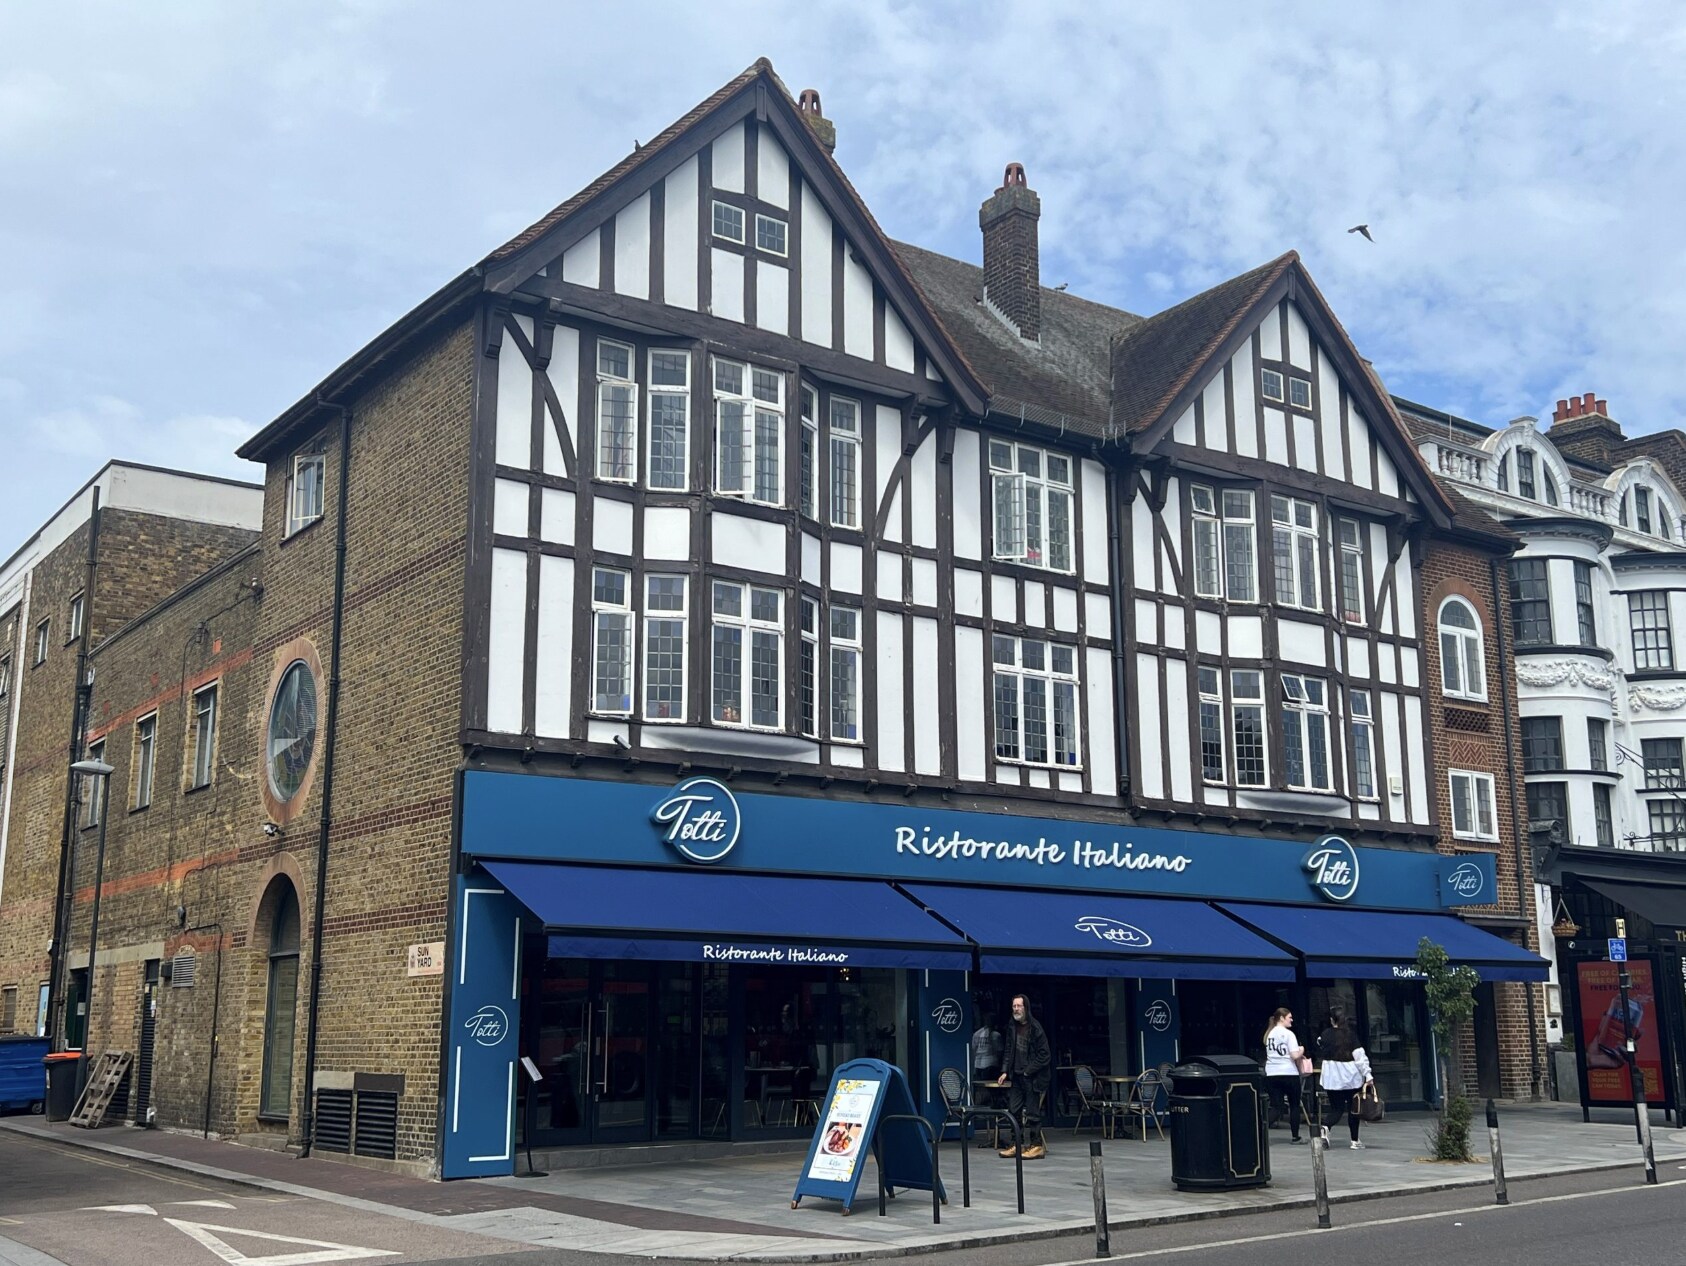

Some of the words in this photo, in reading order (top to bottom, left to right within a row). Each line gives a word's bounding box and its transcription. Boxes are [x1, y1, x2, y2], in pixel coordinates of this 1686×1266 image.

[656, 795, 727, 842] Totti
[895, 825, 1067, 865] Ristorante
[1073, 840, 1193, 873] Italiano
[1307, 849, 1352, 885] Totti
[1447, 869, 1478, 891] Totti
[1074, 922, 1140, 941] Totti
[417, 946, 430, 957] SUN
[703, 944, 785, 962] Ristorante
[788, 948, 849, 963] Italiano
[417, 957, 432, 968] YARD
[931, 1005, 958, 1025] Totti
[1144, 1006, 1167, 1025] Totti
[464, 1013, 501, 1038] Totti
